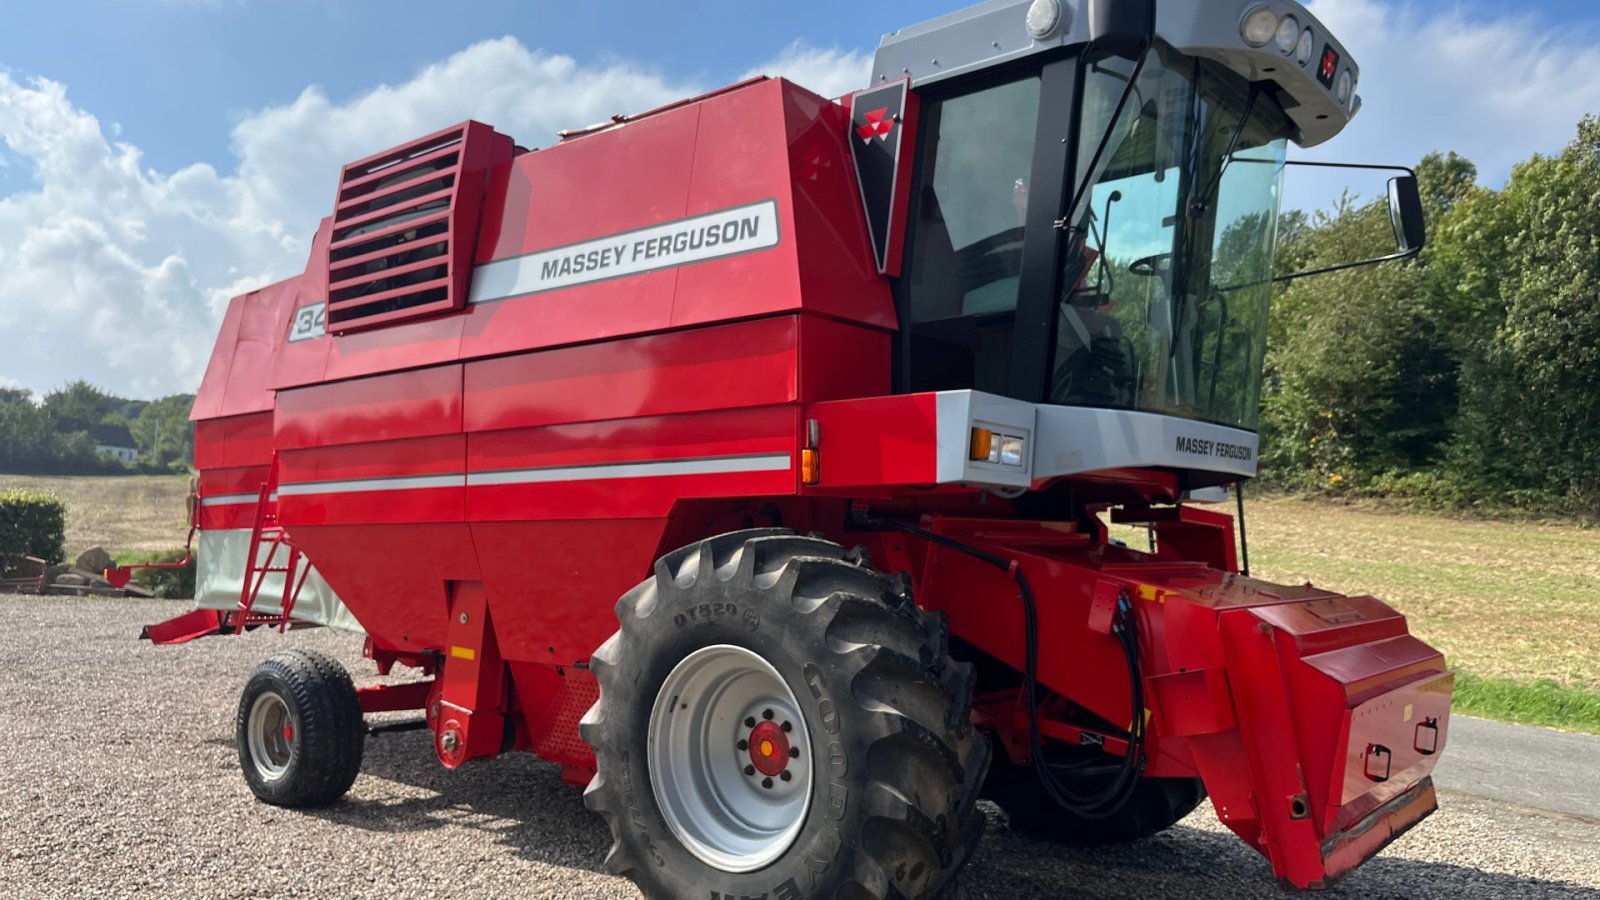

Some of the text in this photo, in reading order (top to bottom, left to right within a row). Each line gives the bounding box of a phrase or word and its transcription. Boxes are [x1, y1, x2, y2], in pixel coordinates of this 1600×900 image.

[540, 216, 760, 281] MASSEY FERGUSON
[1176, 436, 1252, 461] MASSEY FERGUSON
